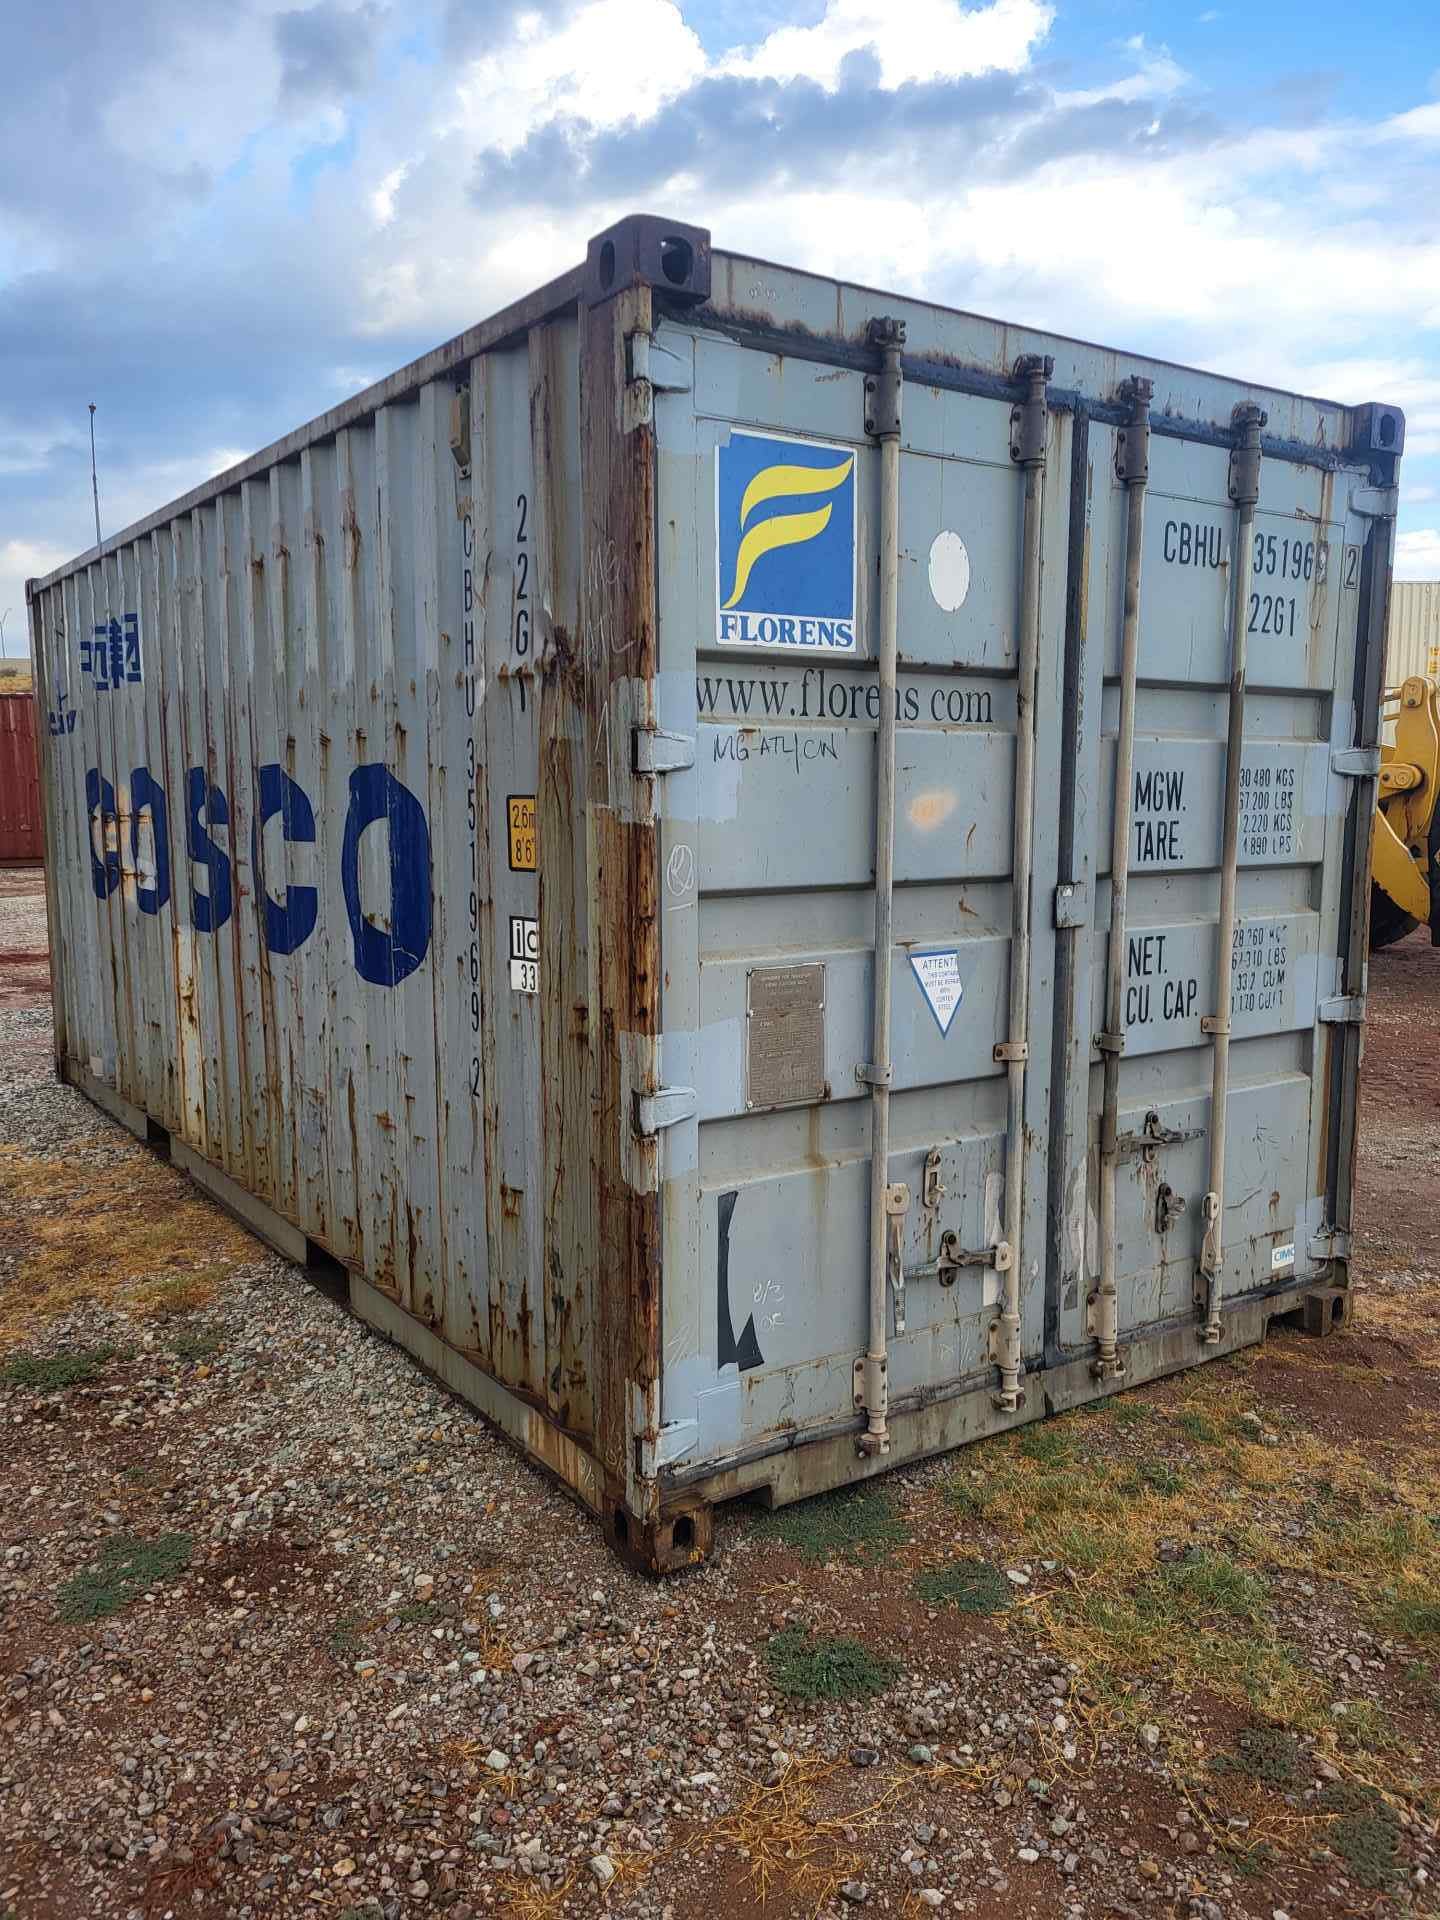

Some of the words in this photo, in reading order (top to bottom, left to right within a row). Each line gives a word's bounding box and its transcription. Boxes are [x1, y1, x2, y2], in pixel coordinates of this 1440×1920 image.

[1163, 520, 1222, 569] CBHU
[719, 614, 854, 648] FLORENS
[1248, 593, 1296, 637] 22G1
[1134, 771, 1187, 812] MGW.
[1134, 820, 1184, 862] TARE.
[85, 762, 433, 987] COSCO
[1128, 935, 1168, 978] NET.
[1126, 986, 1153, 1025] CU.
[1163, 979, 1198, 1020] CAP.
